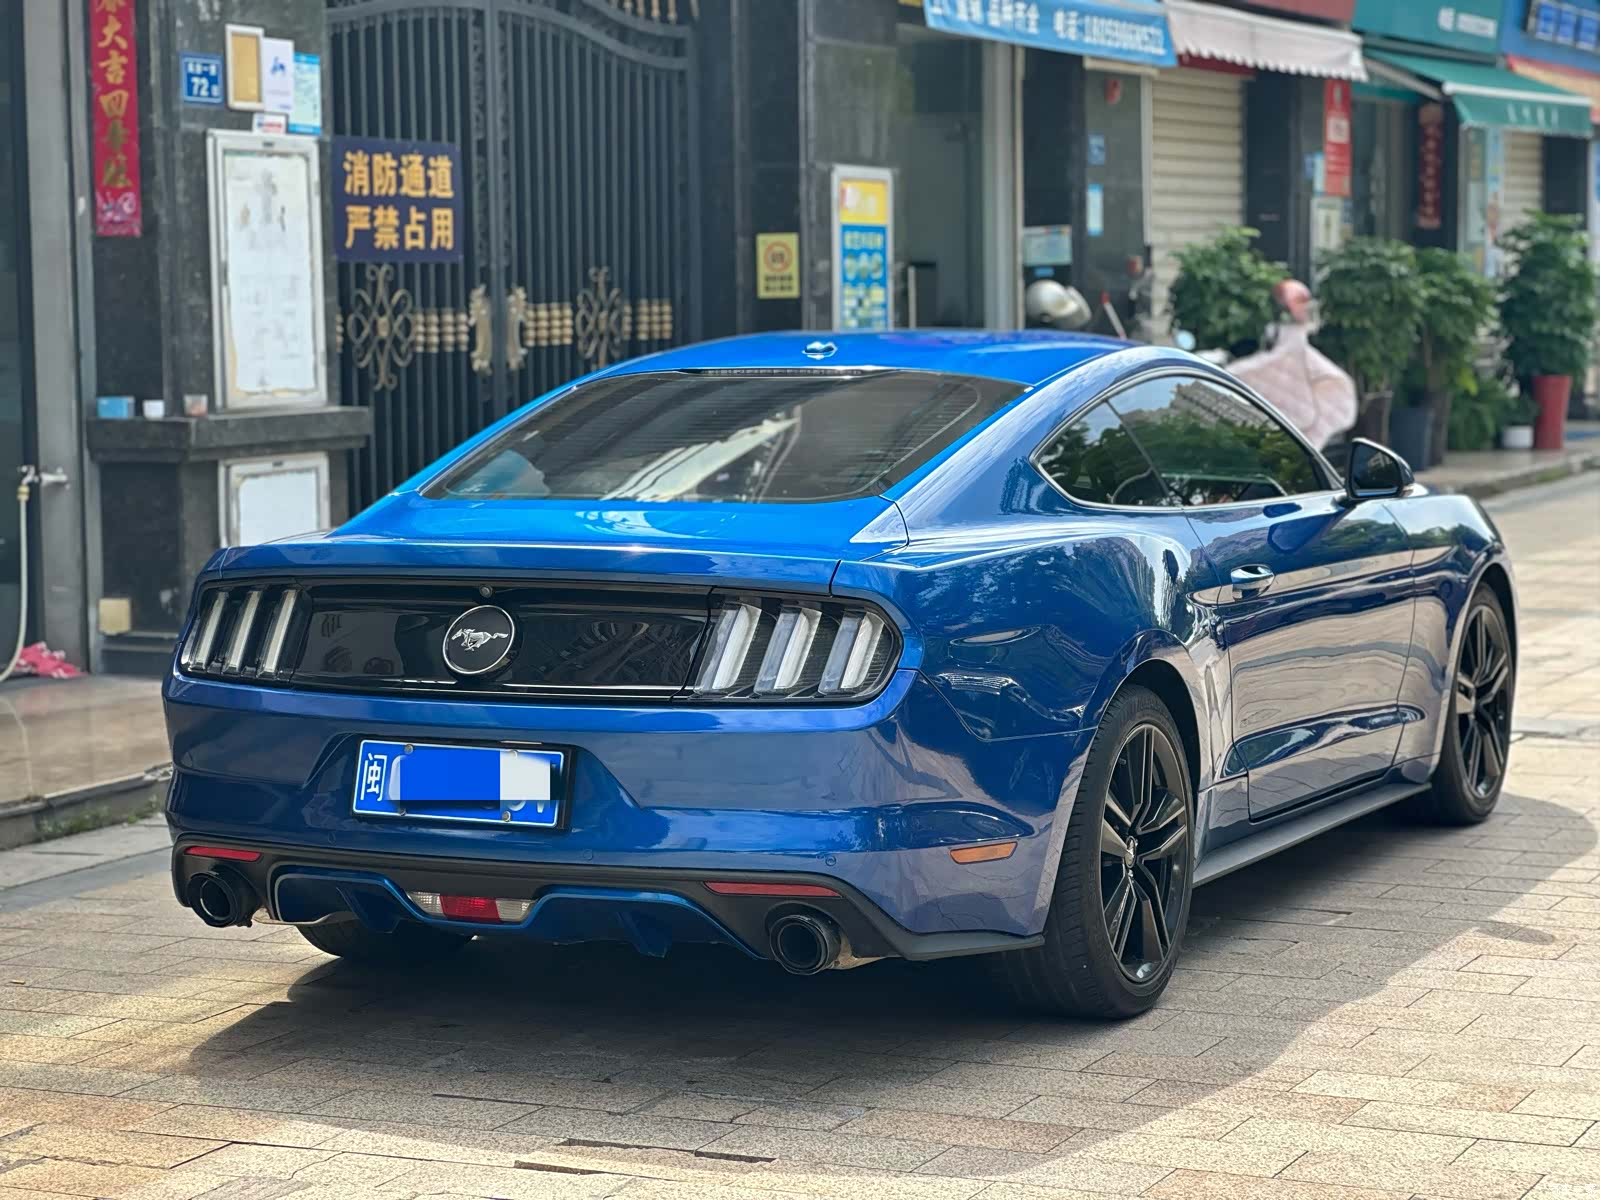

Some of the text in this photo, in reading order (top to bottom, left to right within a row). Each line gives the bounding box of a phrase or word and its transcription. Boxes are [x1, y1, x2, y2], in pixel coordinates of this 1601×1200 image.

[343, 150, 454, 198] 消防通道
[345, 204, 454, 250] 严禁占用
